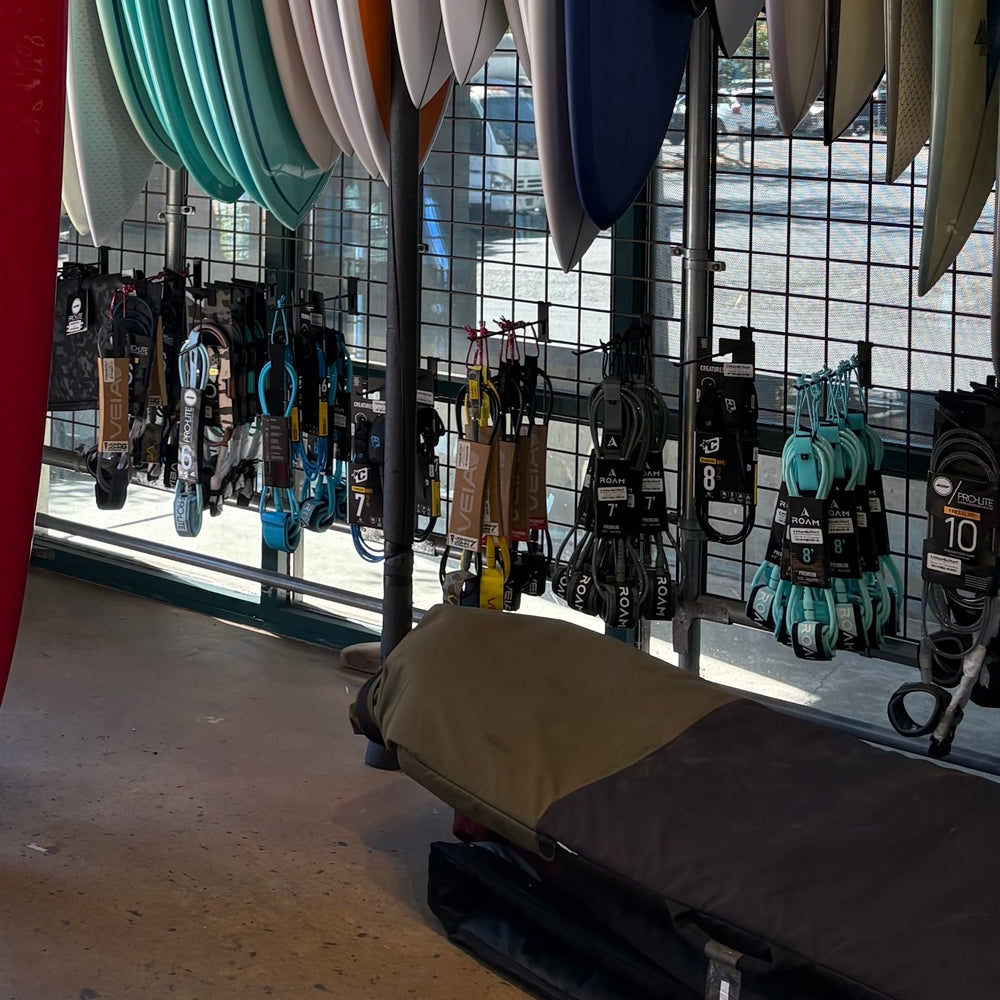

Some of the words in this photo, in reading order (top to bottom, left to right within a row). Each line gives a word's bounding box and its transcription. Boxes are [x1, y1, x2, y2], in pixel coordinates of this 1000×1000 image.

[181, 445, 193, 471] 6
[599, 477, 625, 485] ROAM
[703, 465, 716, 491] 8
[354, 492, 366, 517] 7
[957, 491, 995, 508] PRO-LITE
[791, 516, 820, 527] ROAM
[827, 509, 851, 518] OAM
[945, 516, 978, 553] 10
[618, 585, 630, 628] ROAM
[656, 576, 668, 617] ROAM
